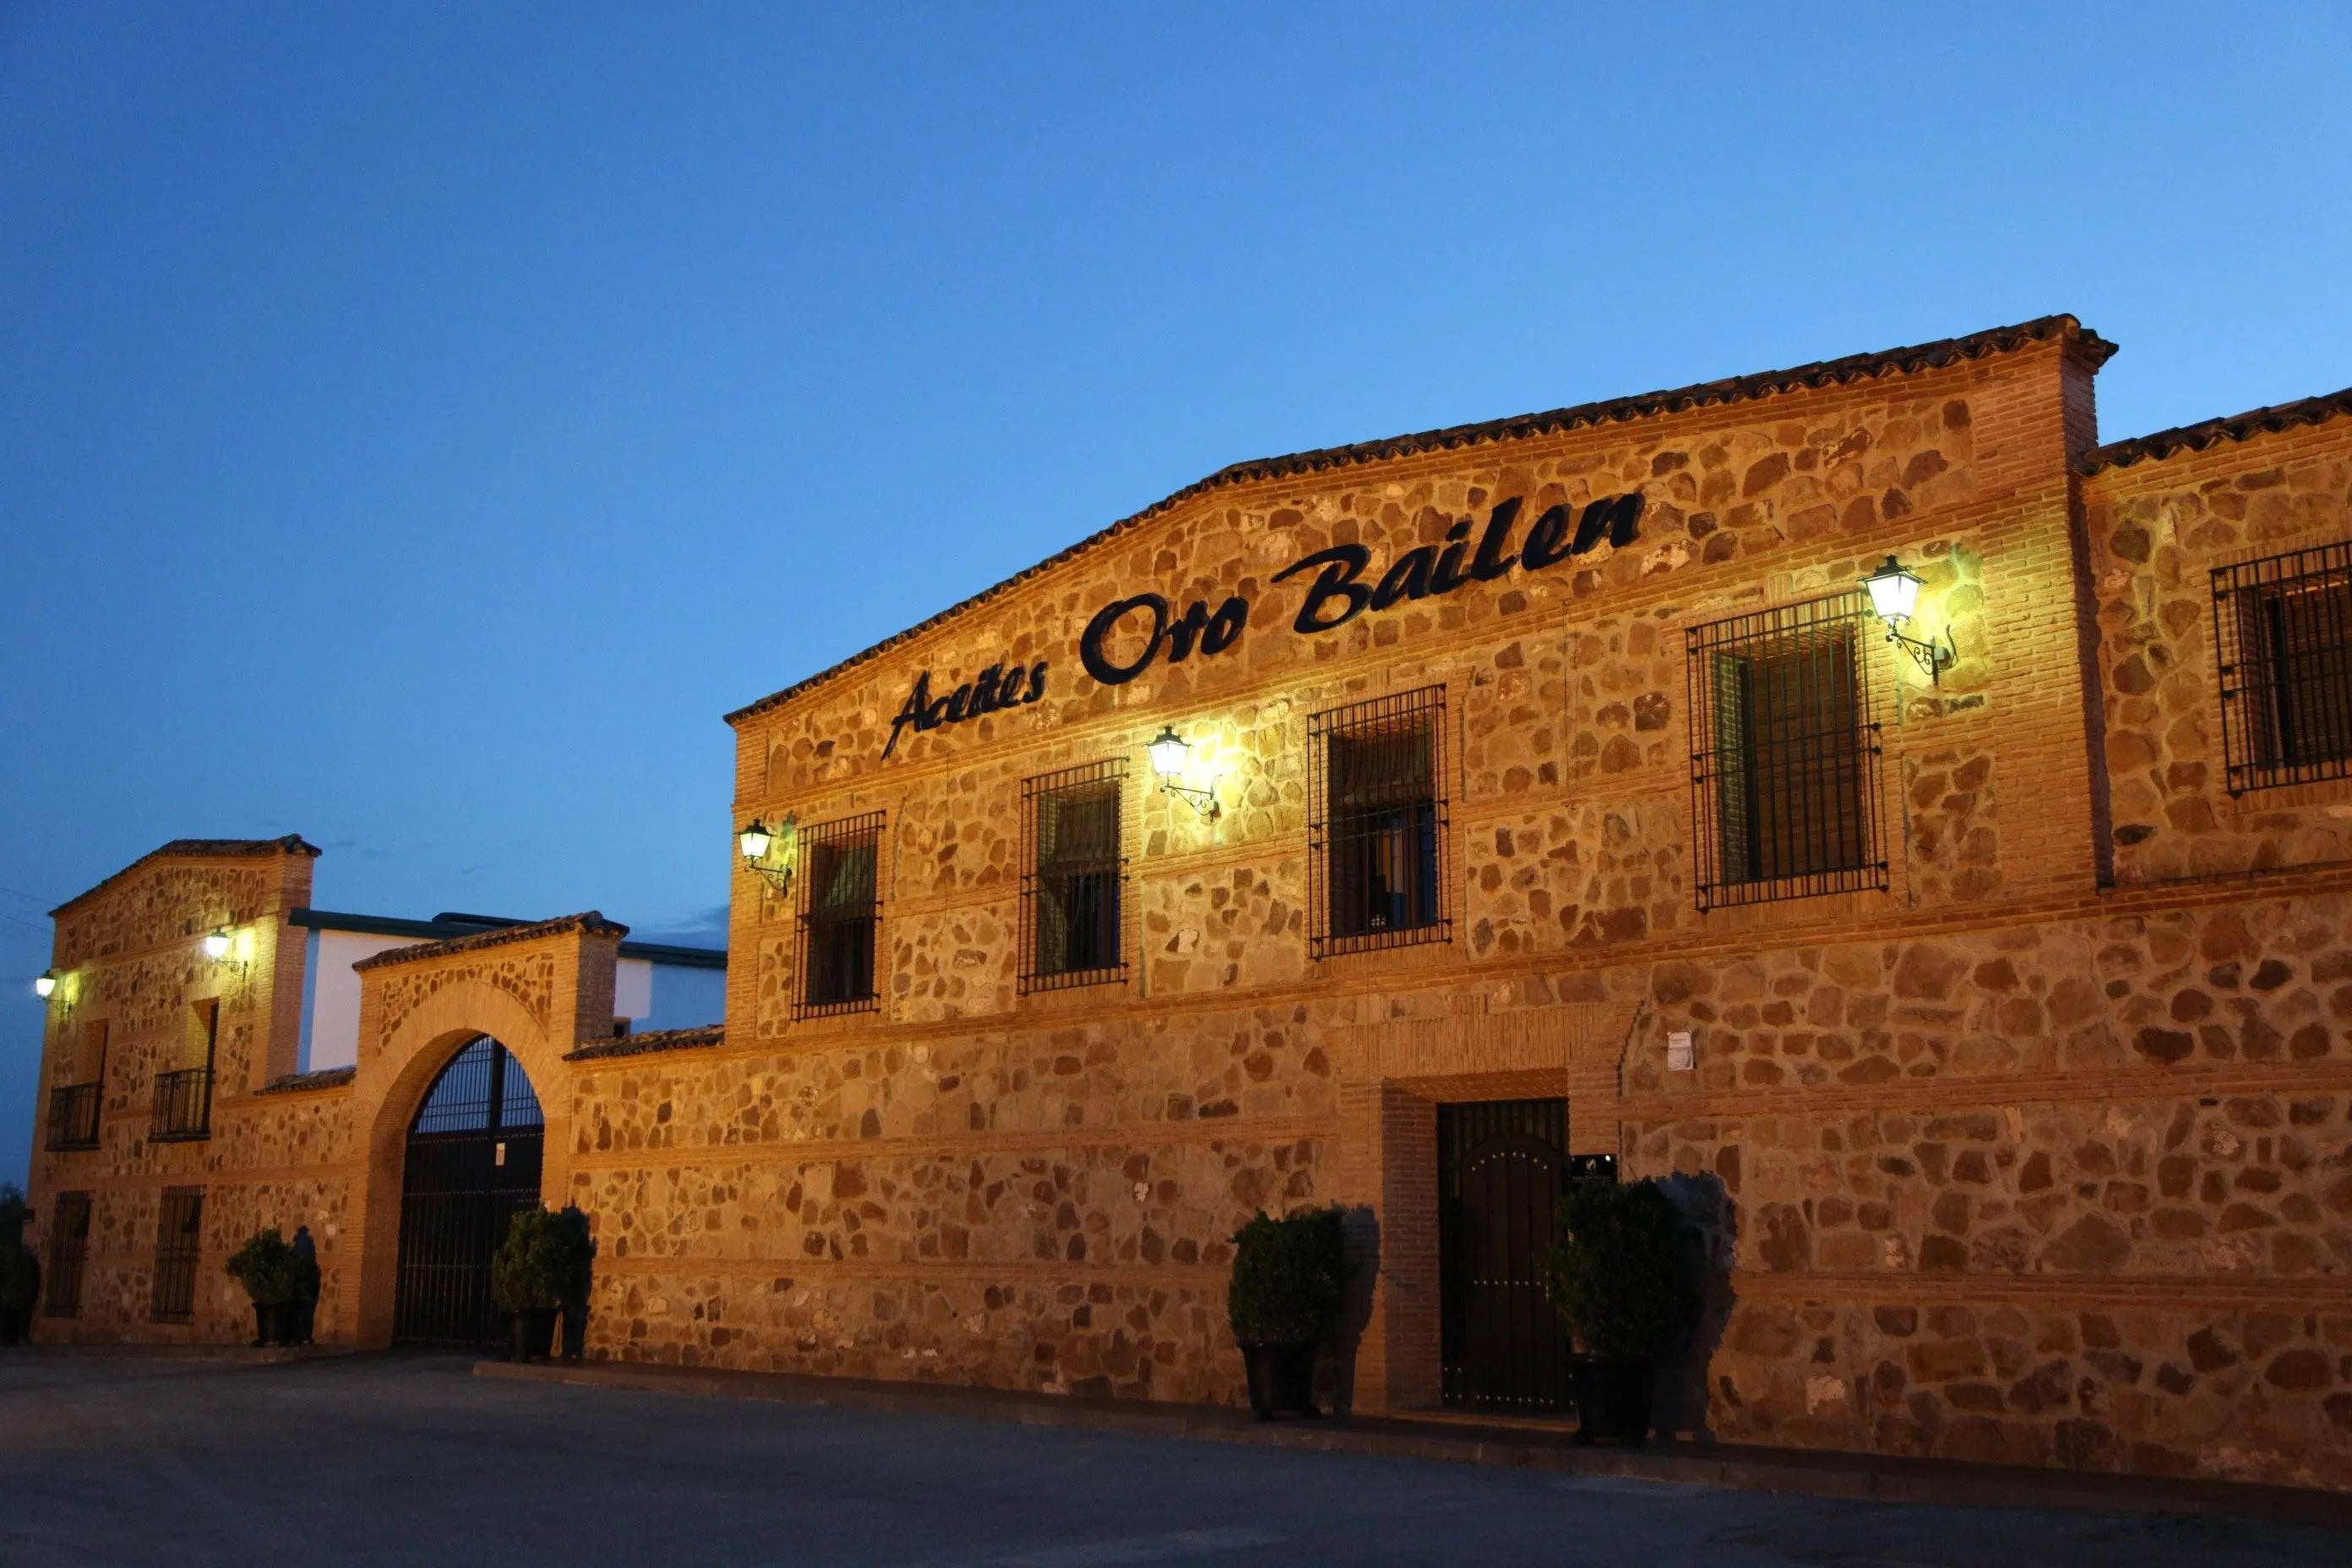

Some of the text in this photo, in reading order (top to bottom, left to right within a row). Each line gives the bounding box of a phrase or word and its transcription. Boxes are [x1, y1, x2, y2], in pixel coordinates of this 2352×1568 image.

[880, 492, 1647, 761] Aceites Oro Bailen
